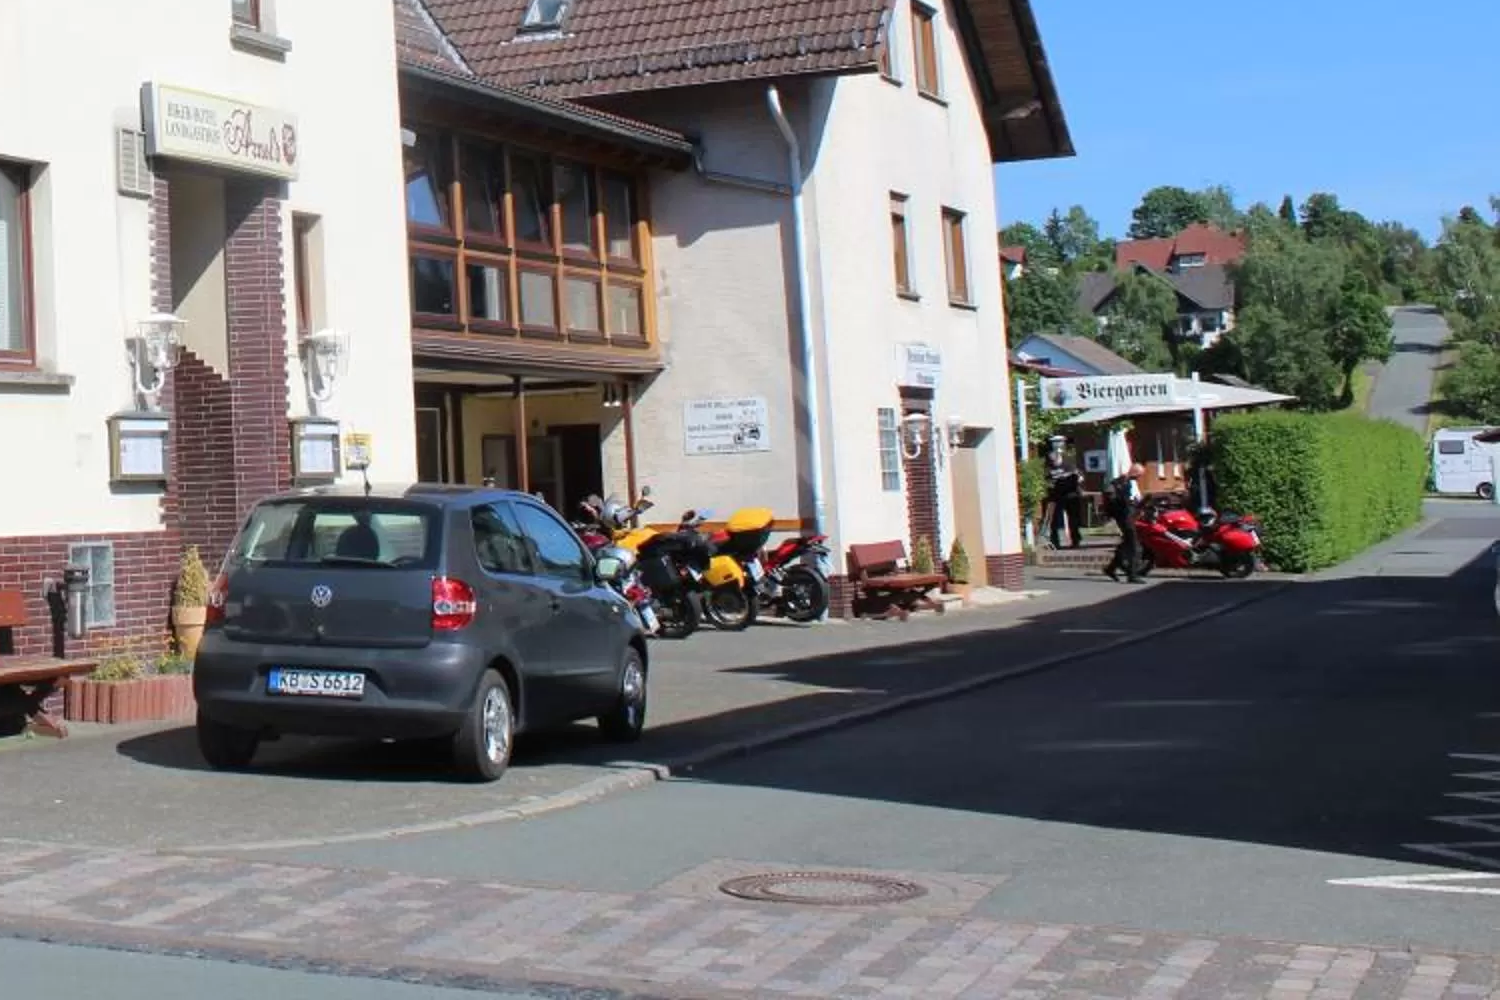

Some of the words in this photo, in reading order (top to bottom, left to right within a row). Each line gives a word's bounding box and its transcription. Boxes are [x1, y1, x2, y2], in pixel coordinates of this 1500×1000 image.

[1075, 381, 1168, 402] Biergarten
[309, 672, 319, 689] S
[323, 673, 363, 691] 6612
